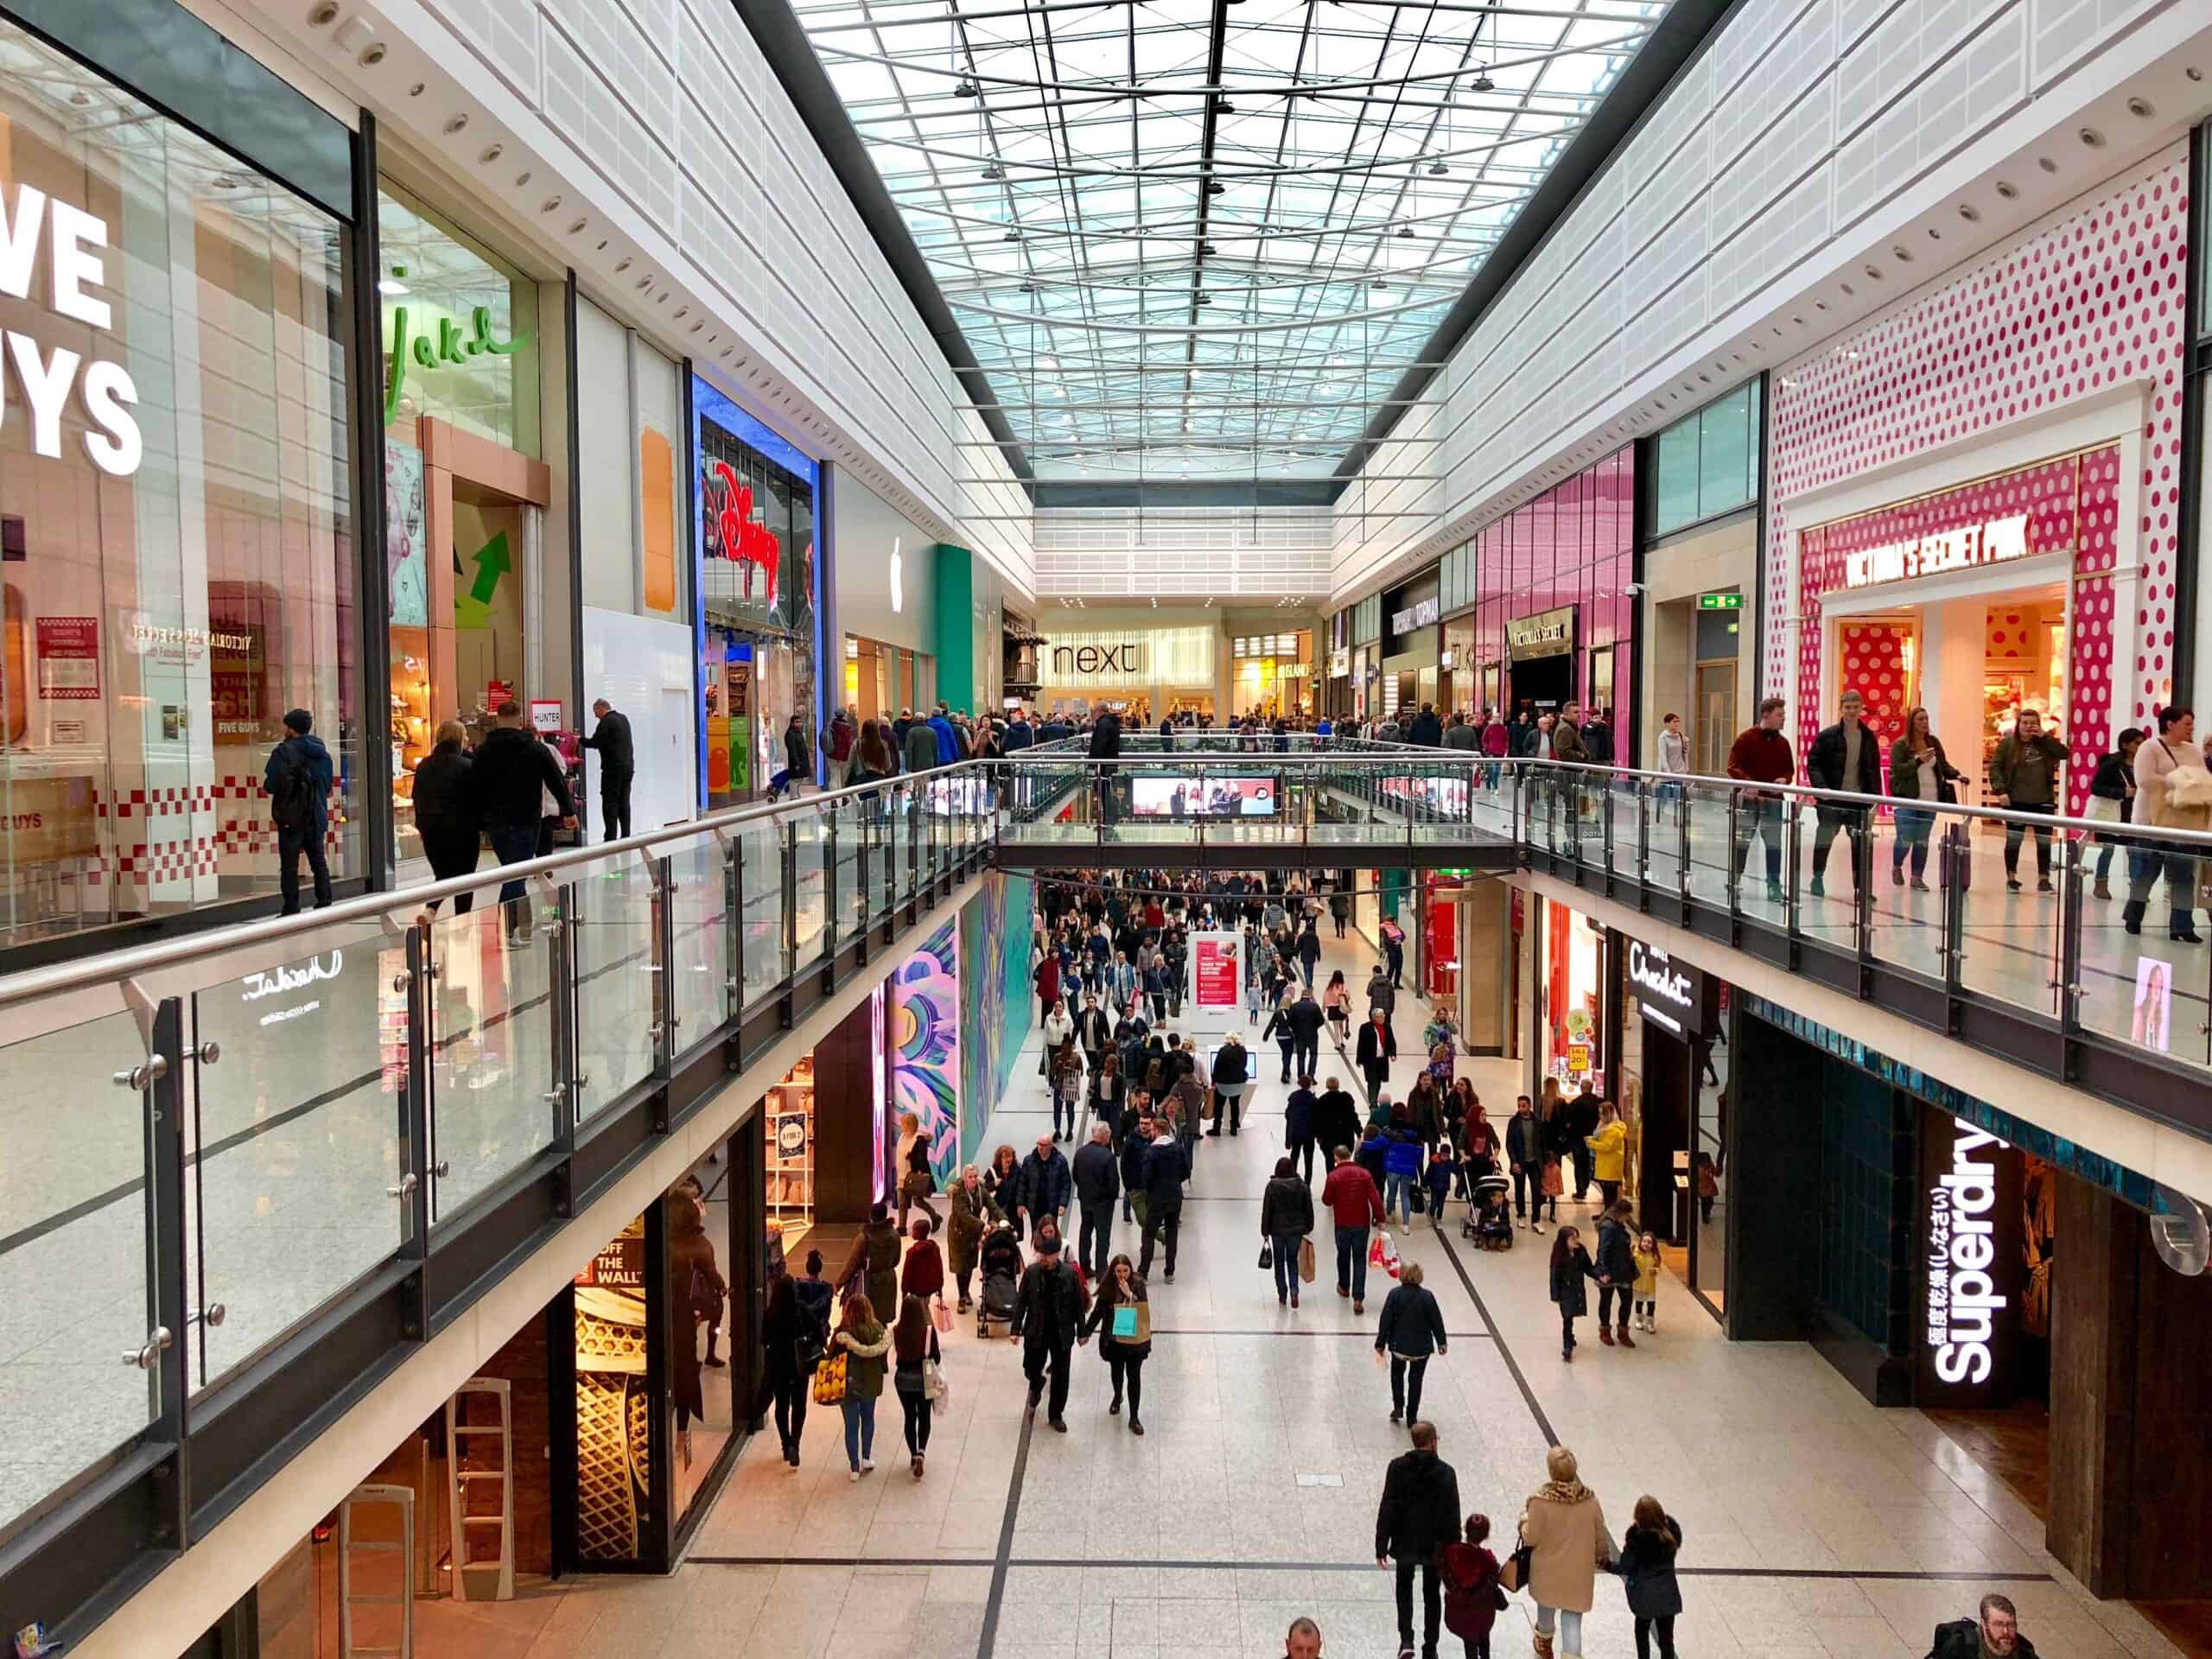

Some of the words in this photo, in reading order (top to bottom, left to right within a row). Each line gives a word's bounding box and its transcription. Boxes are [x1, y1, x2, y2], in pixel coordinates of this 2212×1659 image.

[0, 328, 143, 476] YS
[1054, 643, 1136, 673] next
[219, 722, 237, 733] FIVE
[238, 721, 260, 733] GUYS
[534, 712, 560, 722] HUNTER
[1936, 1116, 2010, 1383] Superdry
[598, 1257, 624, 1269] THE
